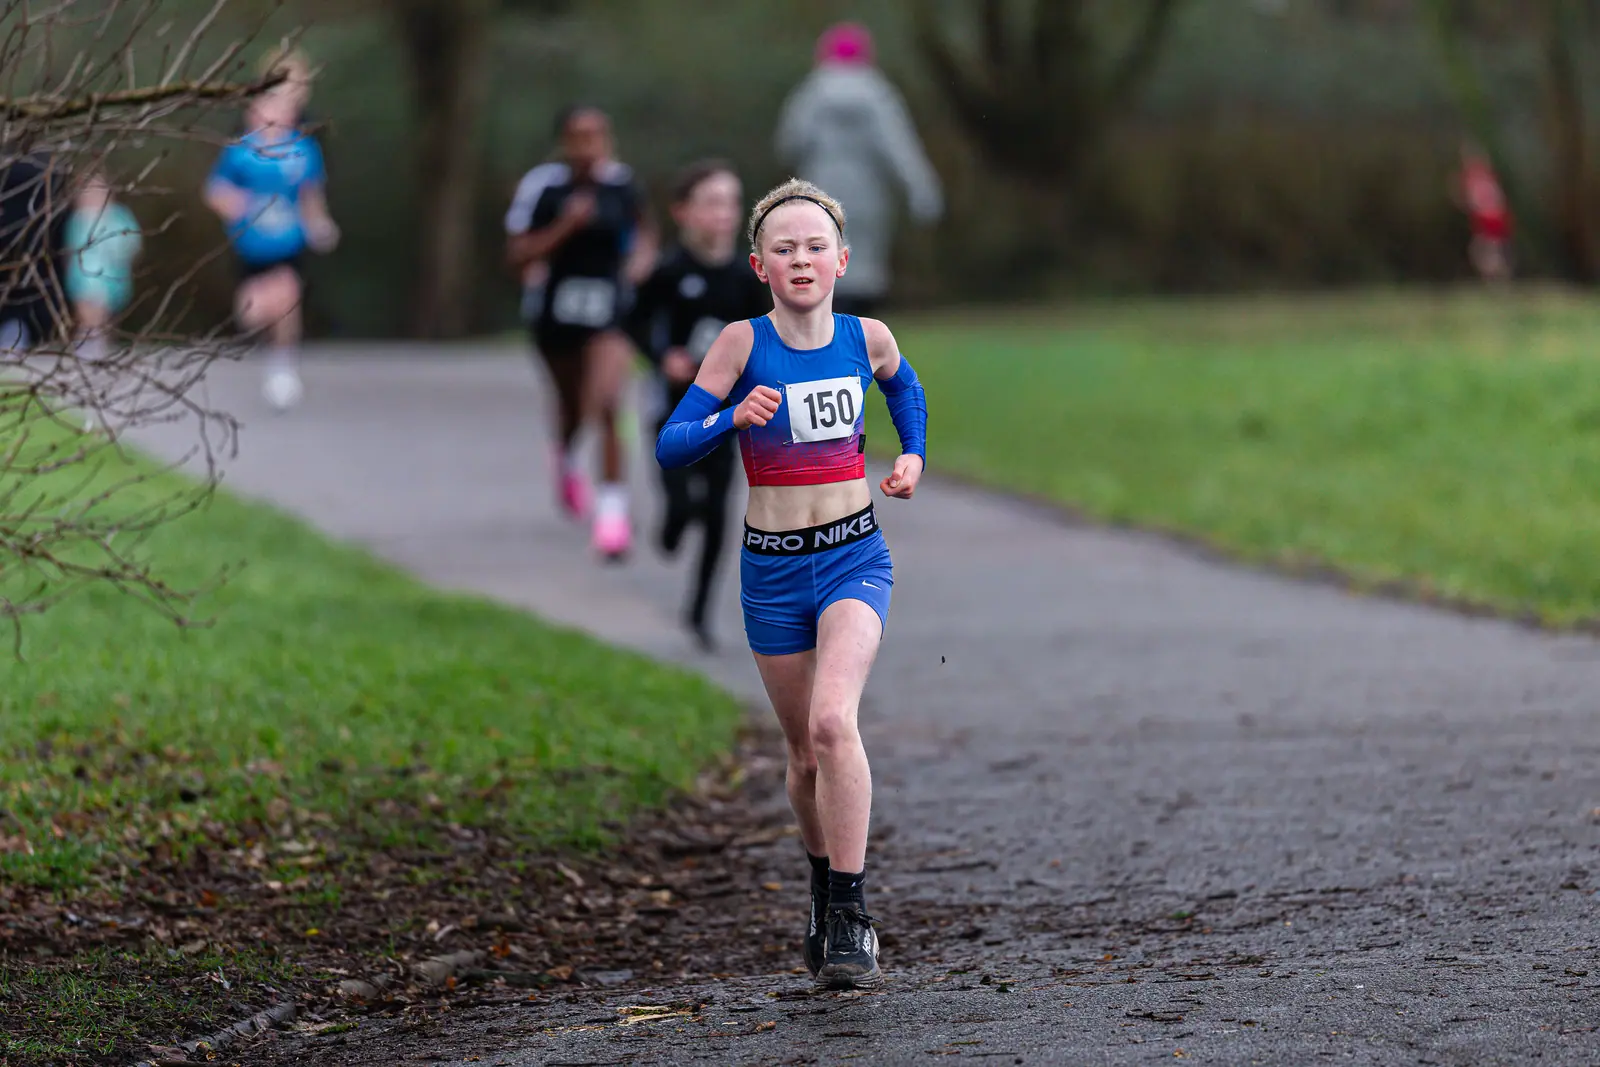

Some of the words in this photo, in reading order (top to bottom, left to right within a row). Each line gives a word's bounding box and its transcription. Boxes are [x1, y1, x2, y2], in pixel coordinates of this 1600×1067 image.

[803, 388, 855, 430] 150
[746, 531, 804, 551] PRO
[813, 511, 873, 548] NIKE
